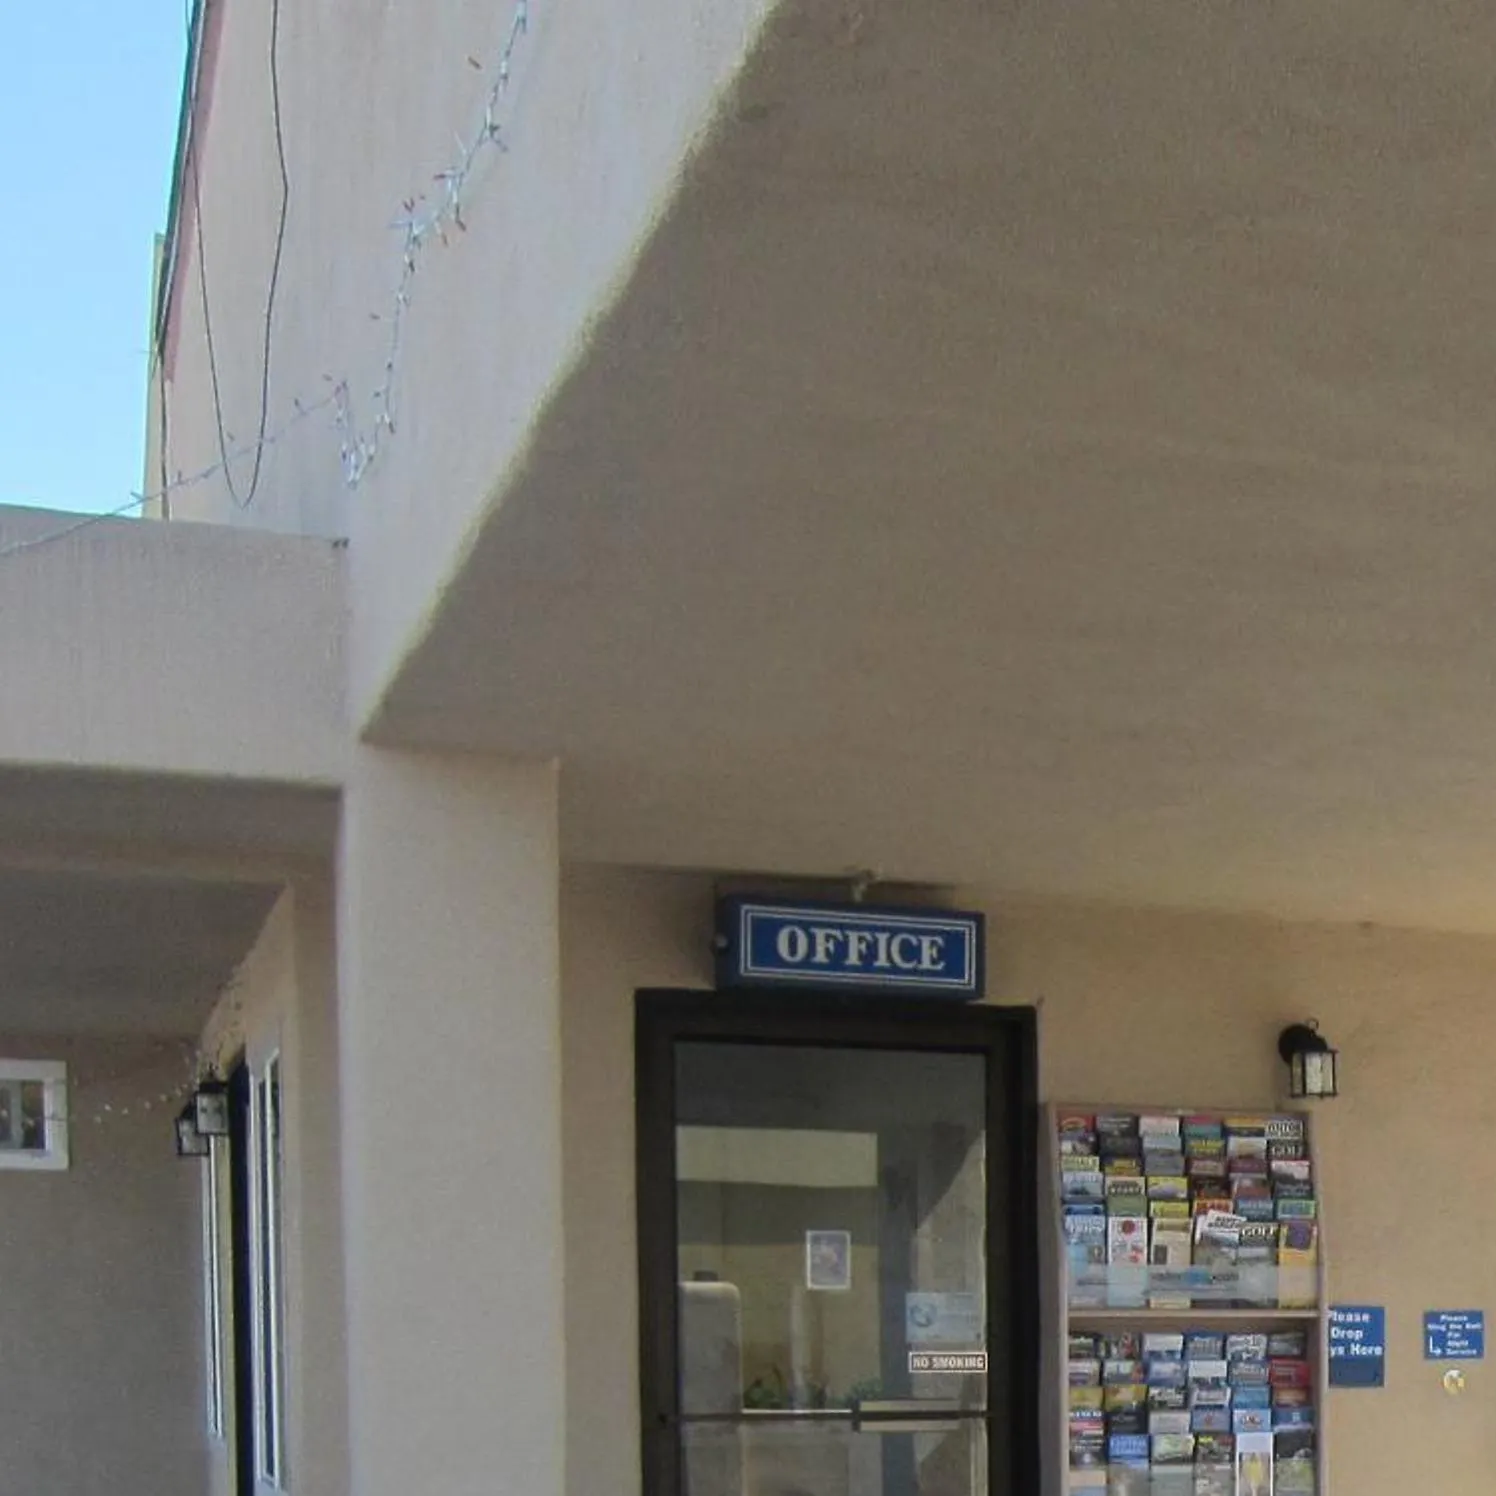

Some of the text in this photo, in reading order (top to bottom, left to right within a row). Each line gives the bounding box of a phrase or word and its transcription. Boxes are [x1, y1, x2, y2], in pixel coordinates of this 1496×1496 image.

[776, 925, 946, 971] OFFICE
[1440, 1314, 1469, 1323] Please
[1331, 1327, 1364, 1341] Drop
[1330, 1343, 1383, 1358] ys Here
[912, 1355, 985, 1369] NO SMOKING
